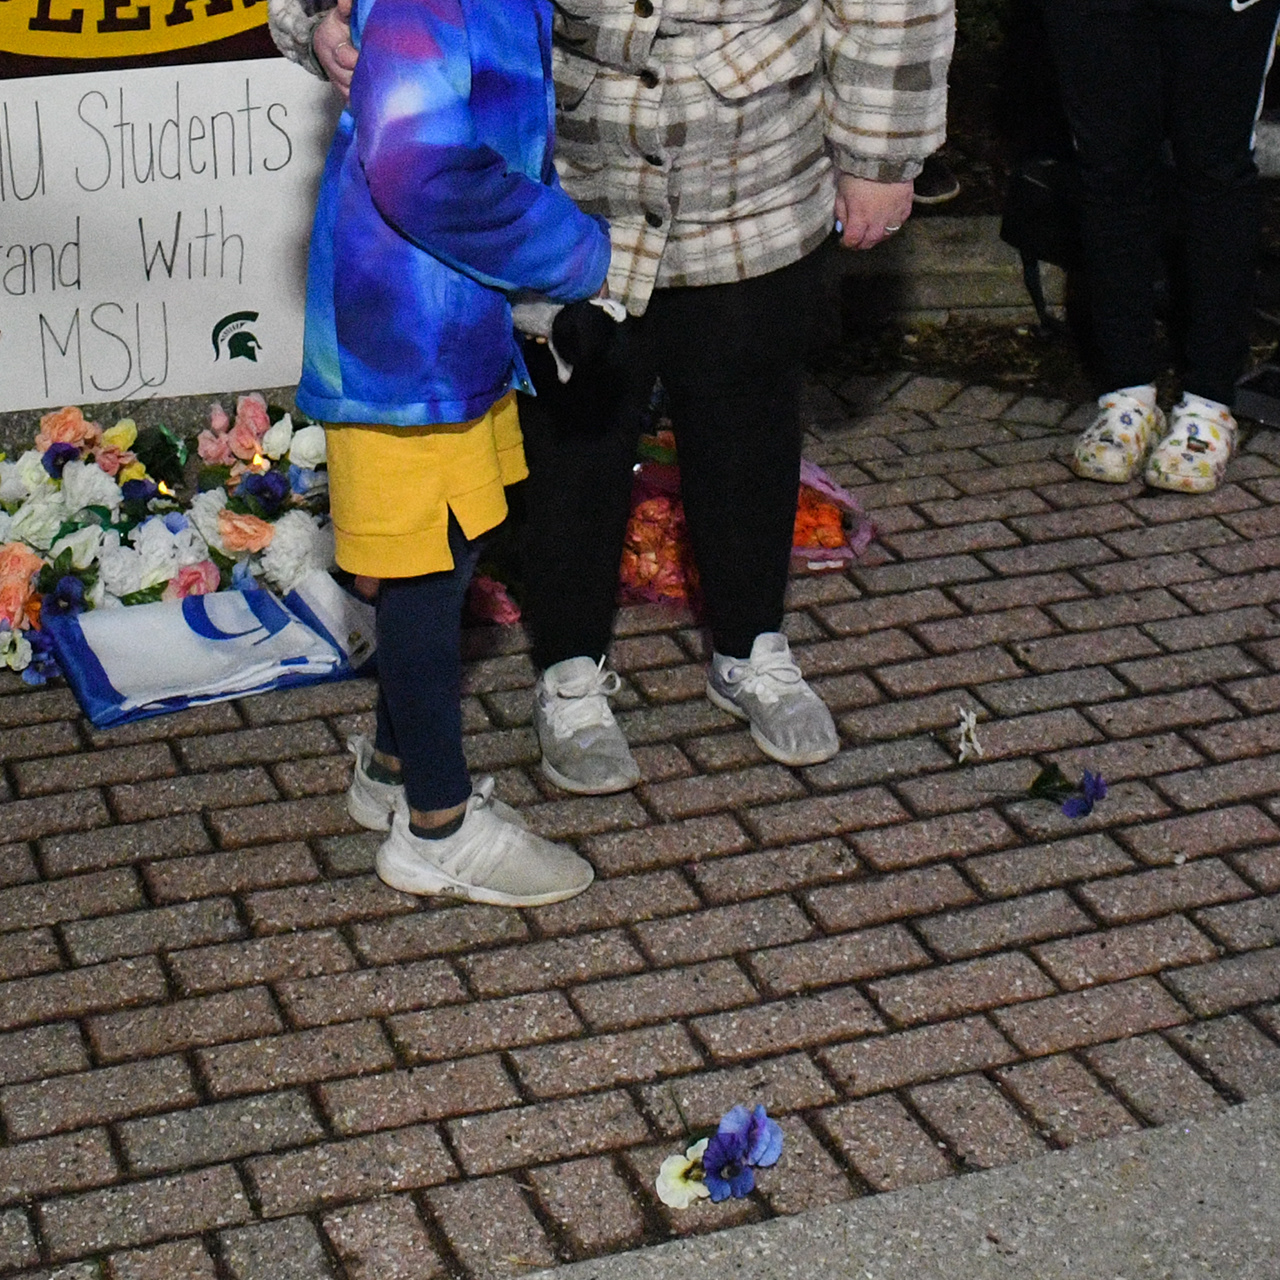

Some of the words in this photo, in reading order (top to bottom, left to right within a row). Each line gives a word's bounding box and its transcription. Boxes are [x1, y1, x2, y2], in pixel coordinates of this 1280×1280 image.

[75, 77, 293, 192] Students
[138, 205, 245, 285] With
[38, 301, 169, 399] MSU
